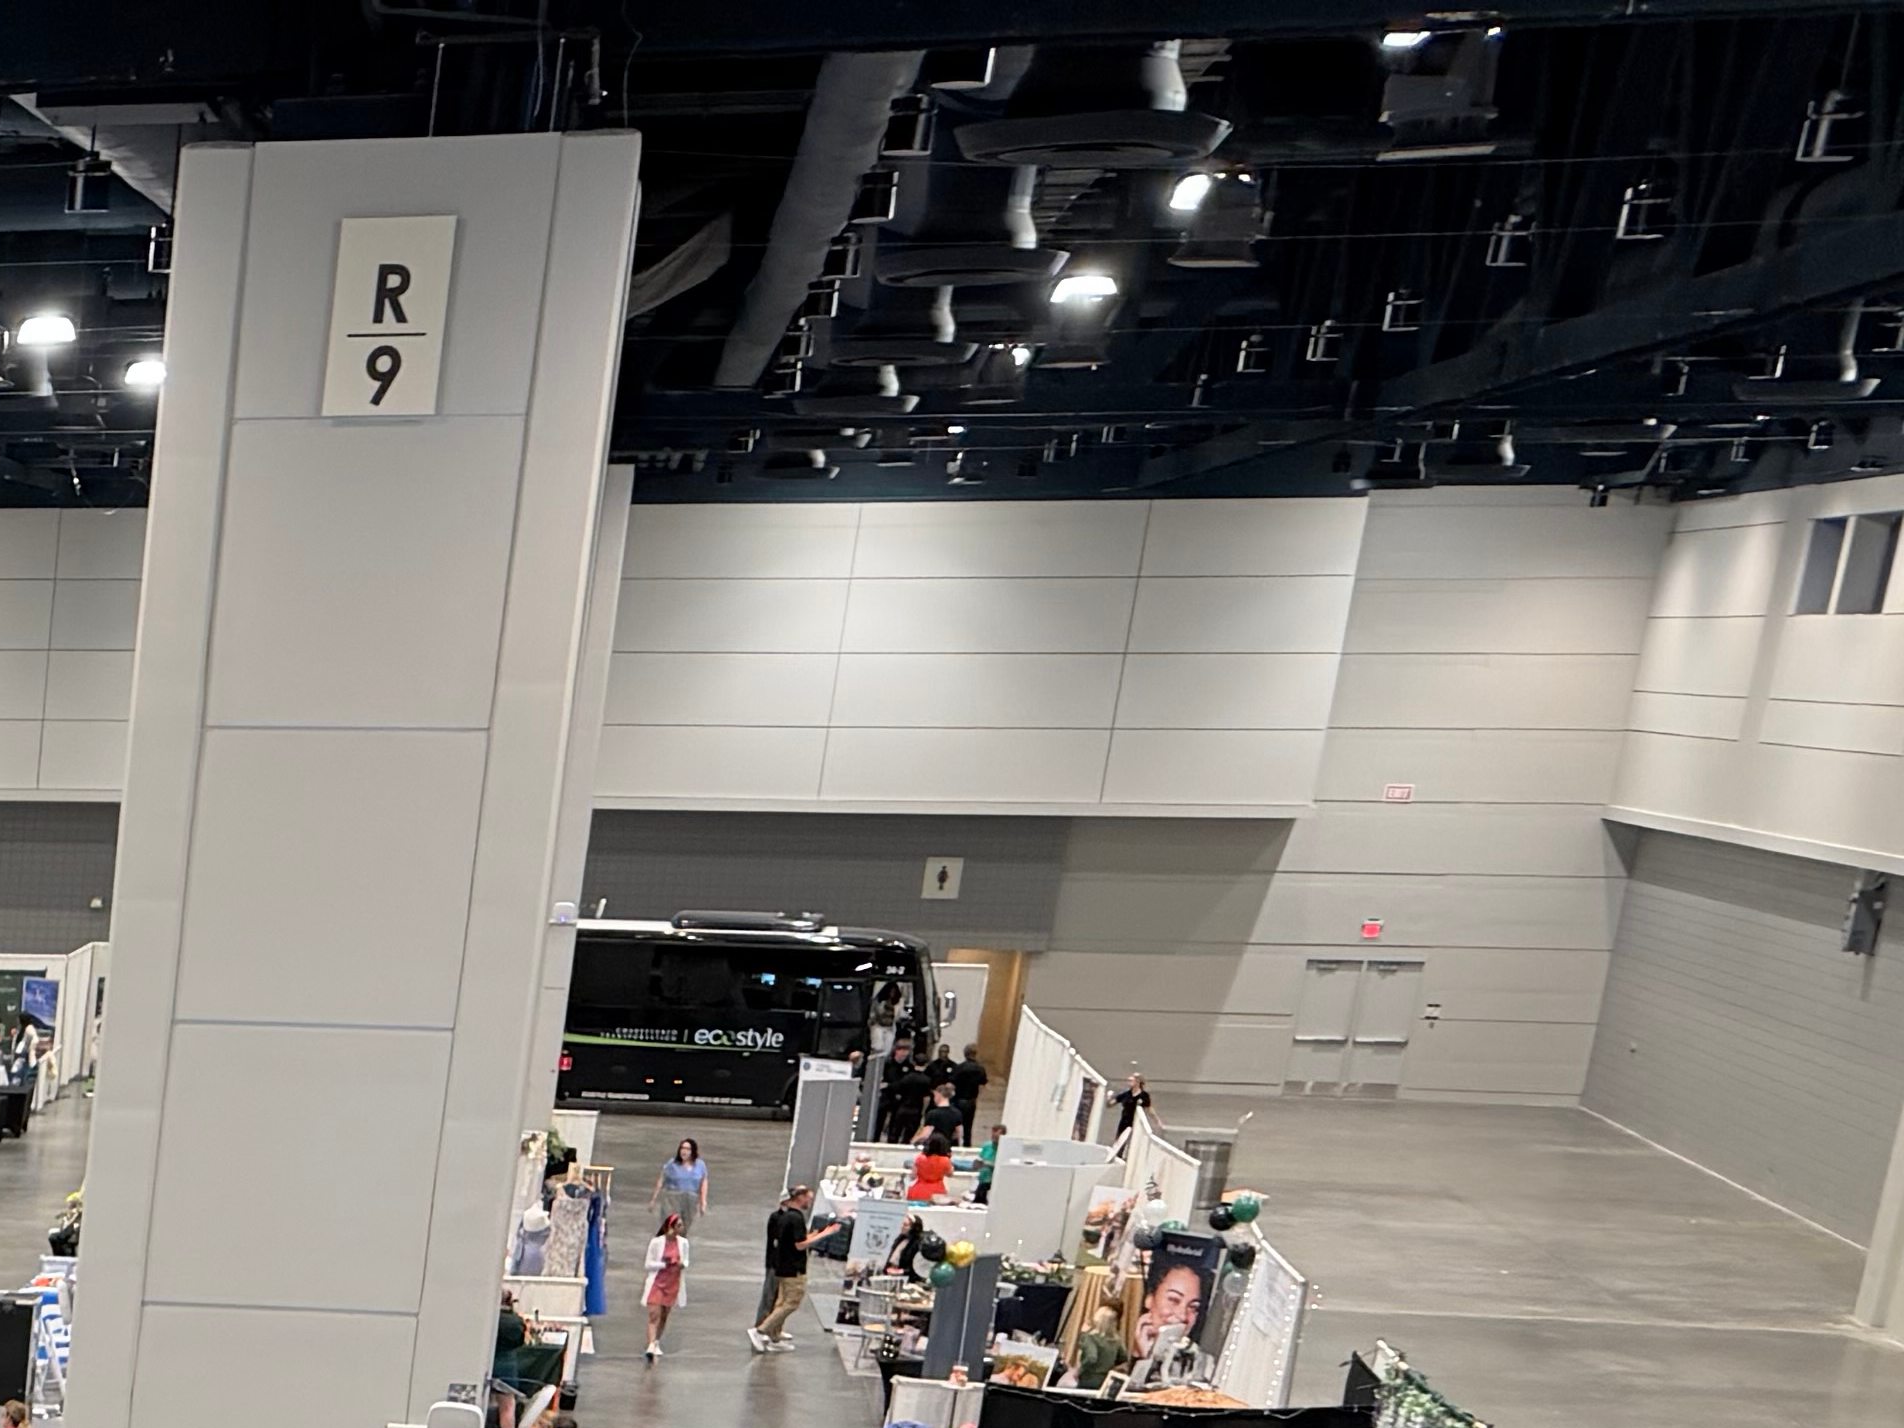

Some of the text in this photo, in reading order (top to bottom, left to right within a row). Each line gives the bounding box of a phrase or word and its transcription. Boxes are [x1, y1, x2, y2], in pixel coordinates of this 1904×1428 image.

[372, 263, 410, 323] R
[365, 345, 401, 405] 9
[694, 1028, 784, 1051] ecostyle
